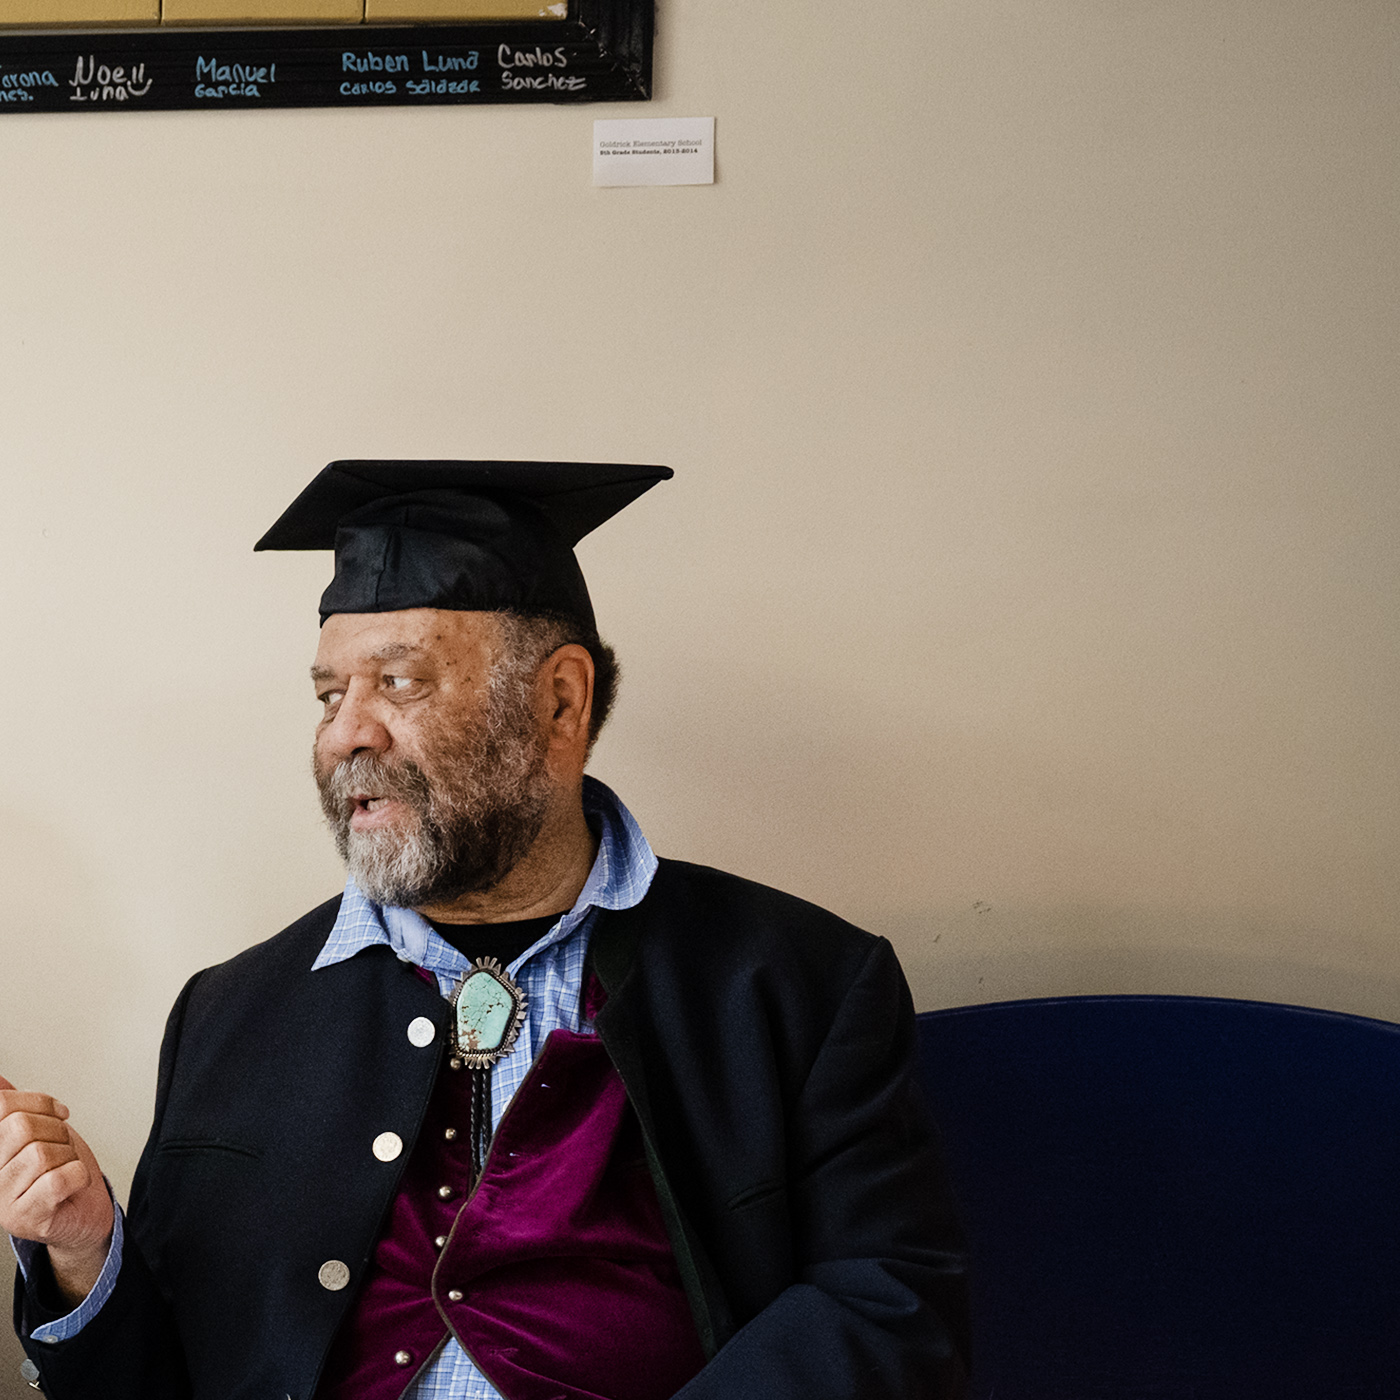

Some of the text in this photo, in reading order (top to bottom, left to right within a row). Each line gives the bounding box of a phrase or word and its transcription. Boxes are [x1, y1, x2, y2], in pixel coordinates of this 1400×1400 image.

[341, 51, 410, 73] Ruben
[497, 43, 567, 69] Carlos
[195, 55, 276, 83] Manuel
[194, 82, 262, 99] Garcia
[501, 70, 588, 91] Sanchez
[632, 139, 676, 148] Elementary
[677, 139, 702, 147] School
